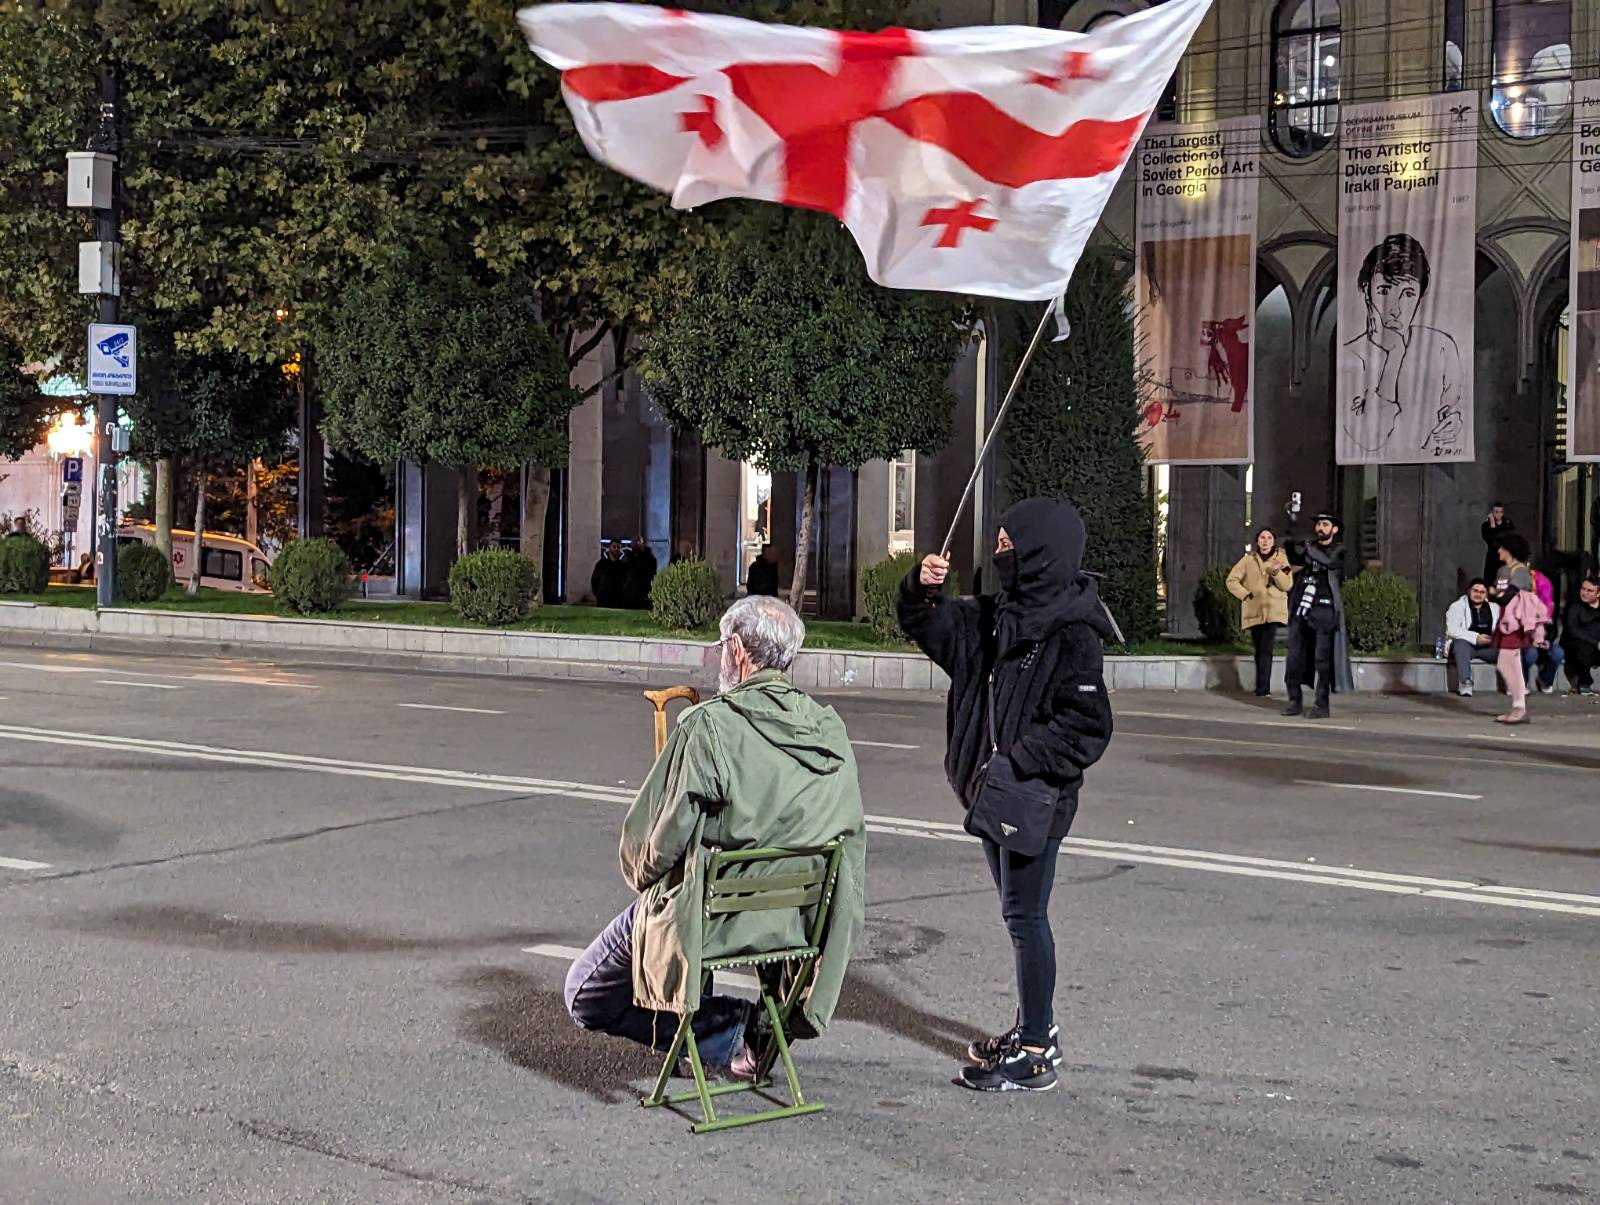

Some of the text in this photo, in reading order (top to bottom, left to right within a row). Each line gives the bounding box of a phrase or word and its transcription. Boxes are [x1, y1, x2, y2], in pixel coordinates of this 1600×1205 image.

[1144, 132, 1221, 150] The Largest
[1345, 140, 1432, 161] The Artistic
[1143, 146, 1225, 165] Collection of
[1142, 160, 1254, 182] Soviet Period Art
[1345, 156, 1429, 177] Diversity of
[1155, 180, 1207, 197] Georgia
[1344, 171, 1439, 194] Irakli Parjiani
[67, 460, 79, 480] P
